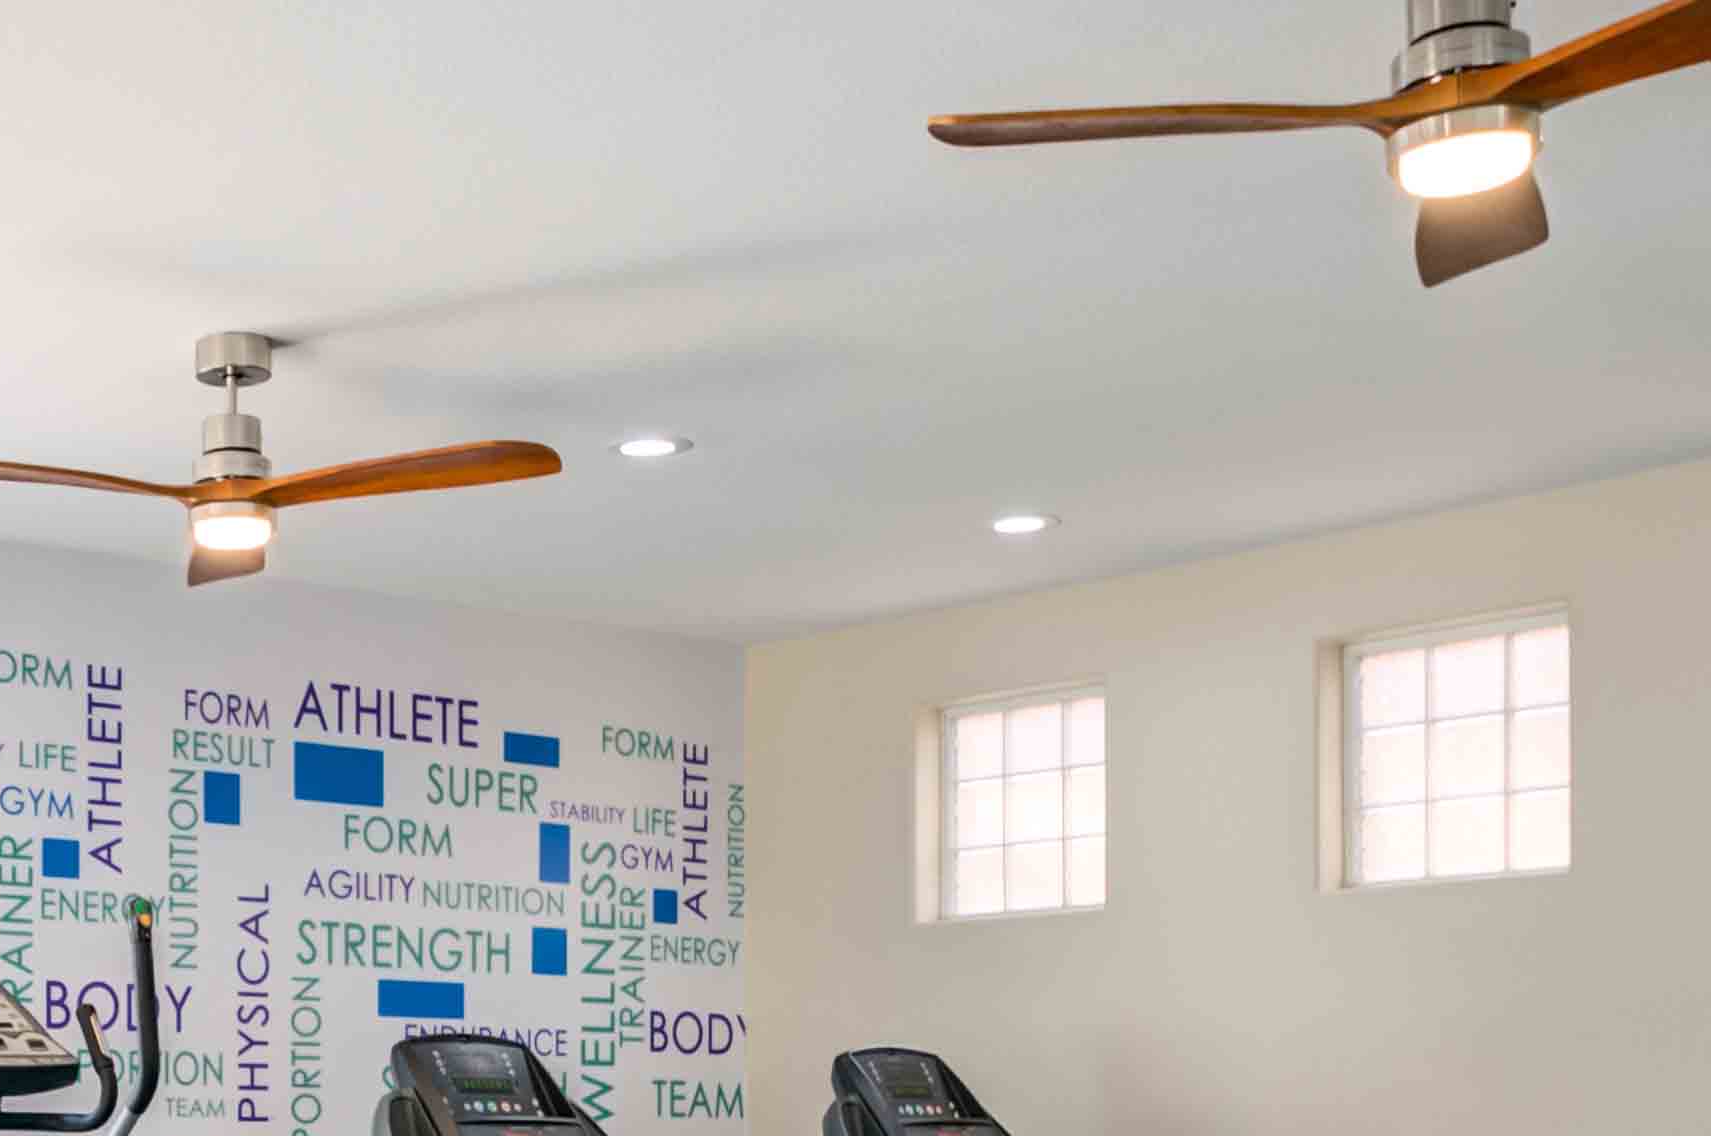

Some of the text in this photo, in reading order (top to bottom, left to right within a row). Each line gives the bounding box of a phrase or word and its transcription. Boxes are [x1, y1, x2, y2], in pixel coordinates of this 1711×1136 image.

[185, 689, 270, 730] FORM
[294, 680, 478, 748] ATHLETE
[19, 741, 76, 772] LIFE
[173, 729, 275, 768] RESULT
[602, 725, 674, 760] FORM
[88, 664, 122, 873] ATHLETE
[427, 762, 537, 814] SUPER
[0, 786, 74, 819] GYM
[550, 801, 625, 825] STABILITY
[633, 808, 676, 838] LIFE
[344, 814, 452, 858] FORM
[682, 741, 709, 920] ATHLETE
[728, 784, 745, 918] NUTRITION
[168, 768, 199, 969] NUTRITION
[620, 844, 674, 873] GYM
[304, 868, 415, 902] AGILITY
[423, 880, 565, 921] NUTRITION
[297, 919, 510, 975] STRENGTH
[619, 887, 646, 1048] TRAINER
[650, 935, 740, 967] ENERGY
[581, 841, 616, 1120] WELLNESS
[238, 884, 270, 1122] PHYSICAL
[166, 1097, 225, 1119] TEAM
[652, 1080, 744, 1120] TEAM
